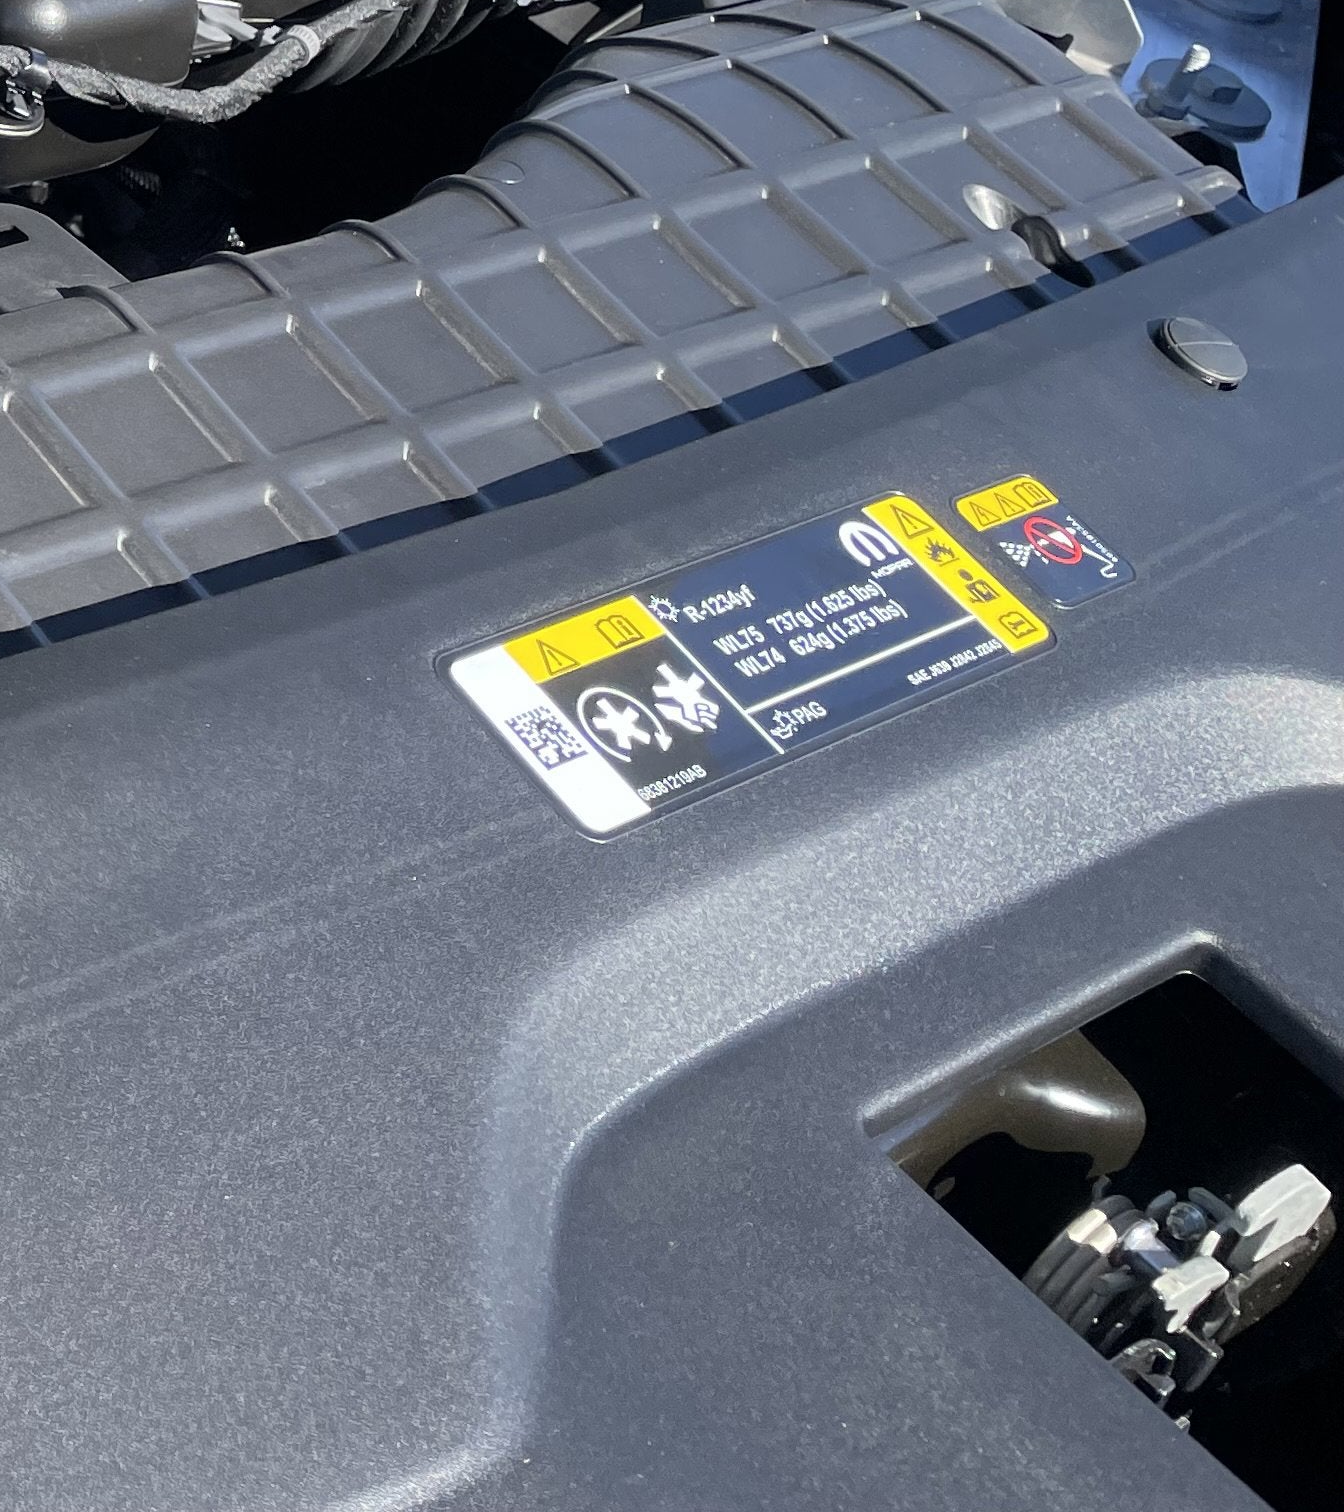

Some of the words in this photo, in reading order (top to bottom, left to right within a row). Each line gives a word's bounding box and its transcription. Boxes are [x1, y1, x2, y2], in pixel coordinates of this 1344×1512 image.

[872, 557, 915, 579] MOPAR
[683, 583, 757, 624] R-1234yf
[712, 625, 765, 657] WL75
[767, 606, 809, 637] 737g
[809, 592, 853, 624] (1.625
[853, 579, 885, 604] lbs)
[734, 647, 786, 678] WL74
[791, 630, 832, 659] 624g
[830, 614, 875, 647] (1.375
[873, 600, 909, 625] lbs)
[908, 667, 931, 686] SAE
[792, 699, 827, 727] PAG
